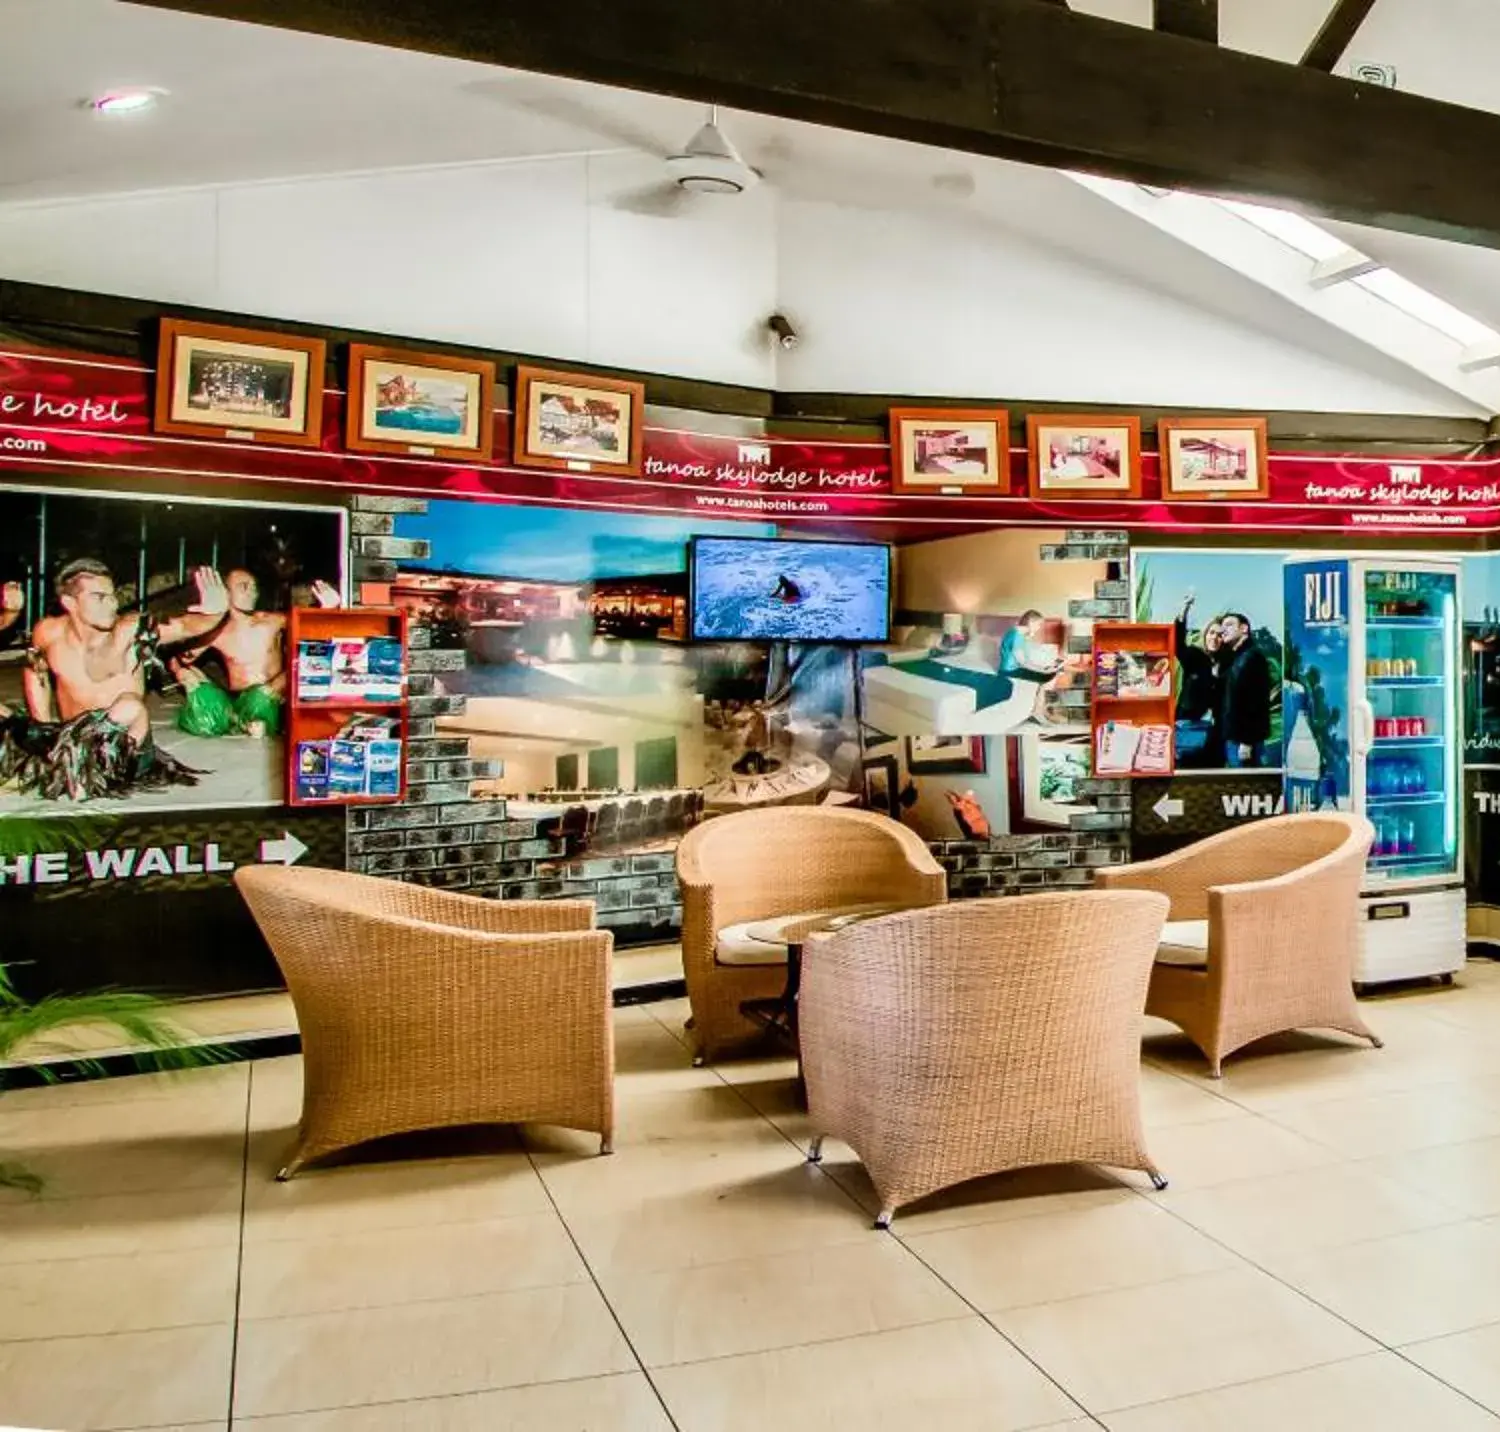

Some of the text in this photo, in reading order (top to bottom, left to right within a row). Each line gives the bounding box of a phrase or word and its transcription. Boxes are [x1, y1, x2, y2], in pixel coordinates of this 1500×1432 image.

[33, 392, 129, 423] hotel
[644, 456, 882, 489] tanoa skylodge hotel
[695, 494, 829, 512] www.tanoahotels.com
[1304, 481, 1366, 500] tanoa
[1369, 483, 1455, 505] skylodge
[1304, 571, 1342, 622] FIJI
[1385, 572, 1417, 591] FIJI
[85, 843, 236, 879] WALL
